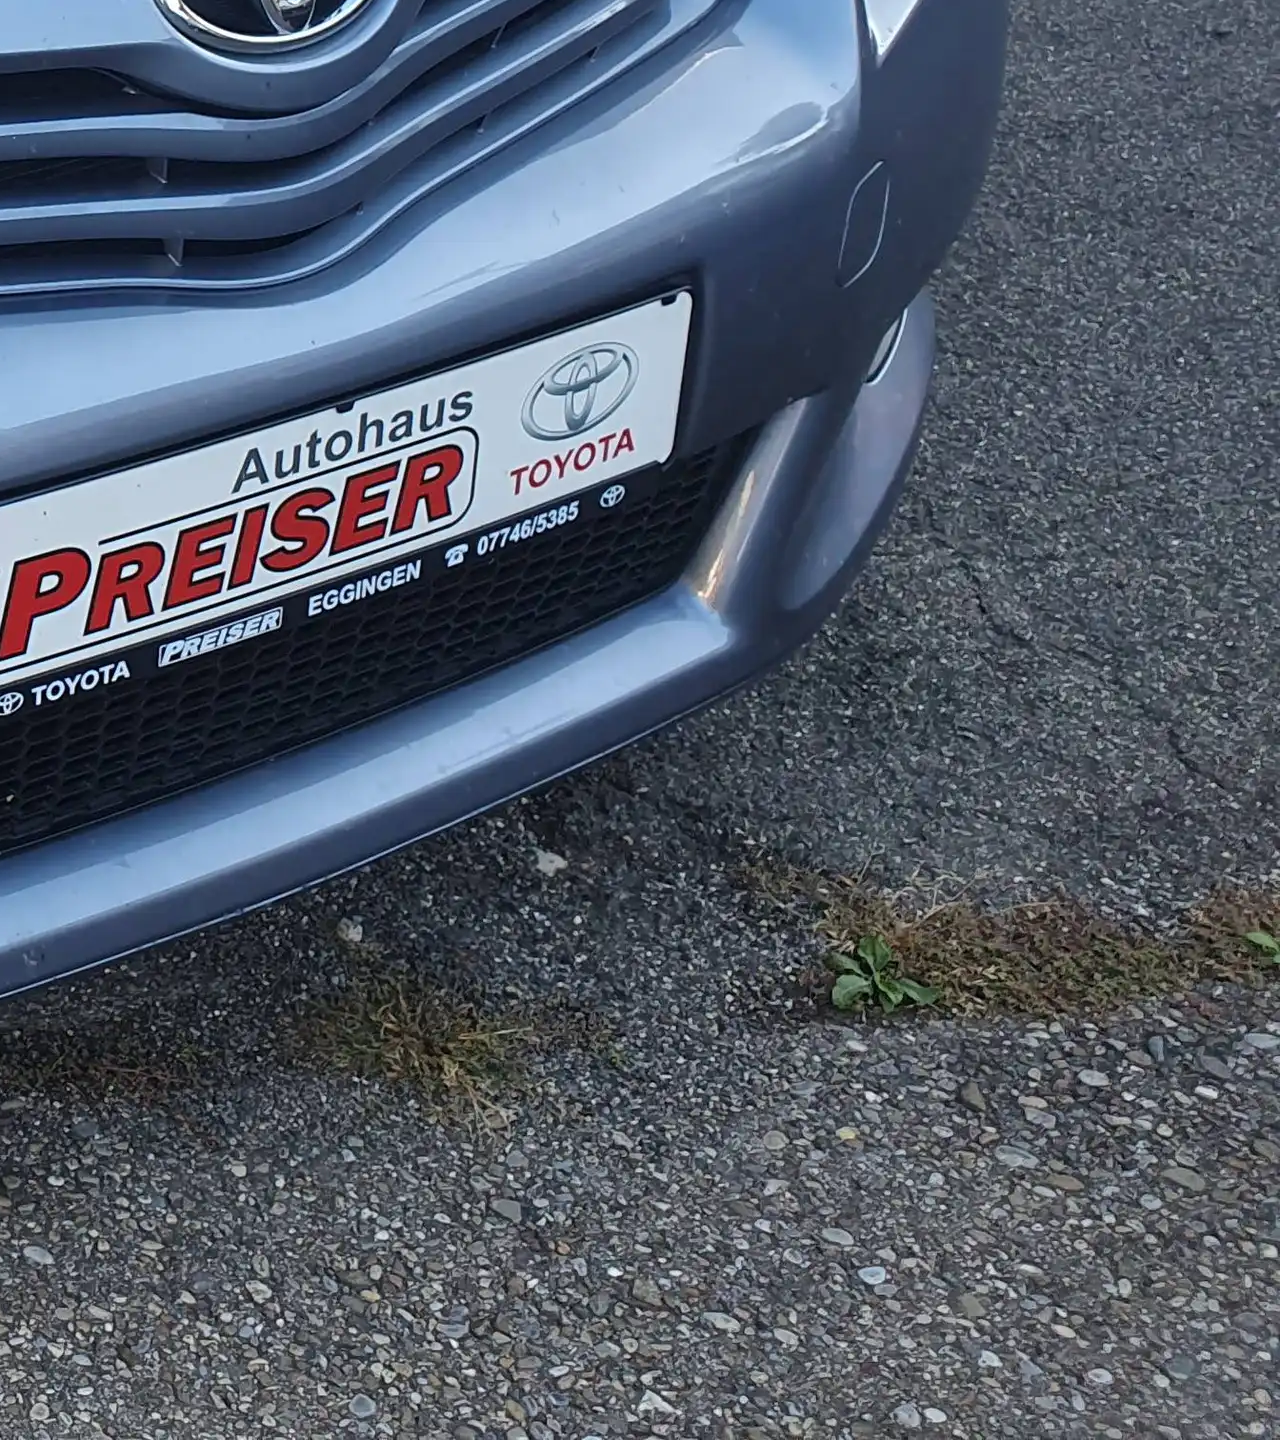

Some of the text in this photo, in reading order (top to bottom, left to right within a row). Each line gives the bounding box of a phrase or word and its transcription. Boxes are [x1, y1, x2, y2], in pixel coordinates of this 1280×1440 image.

[231, 390, 474, 494] Autohaus
[510, 427, 635, 496] TOYOTA
[30, 500, 580, 707] TOYOTA PREISER EGGINGEN 07746/5385
